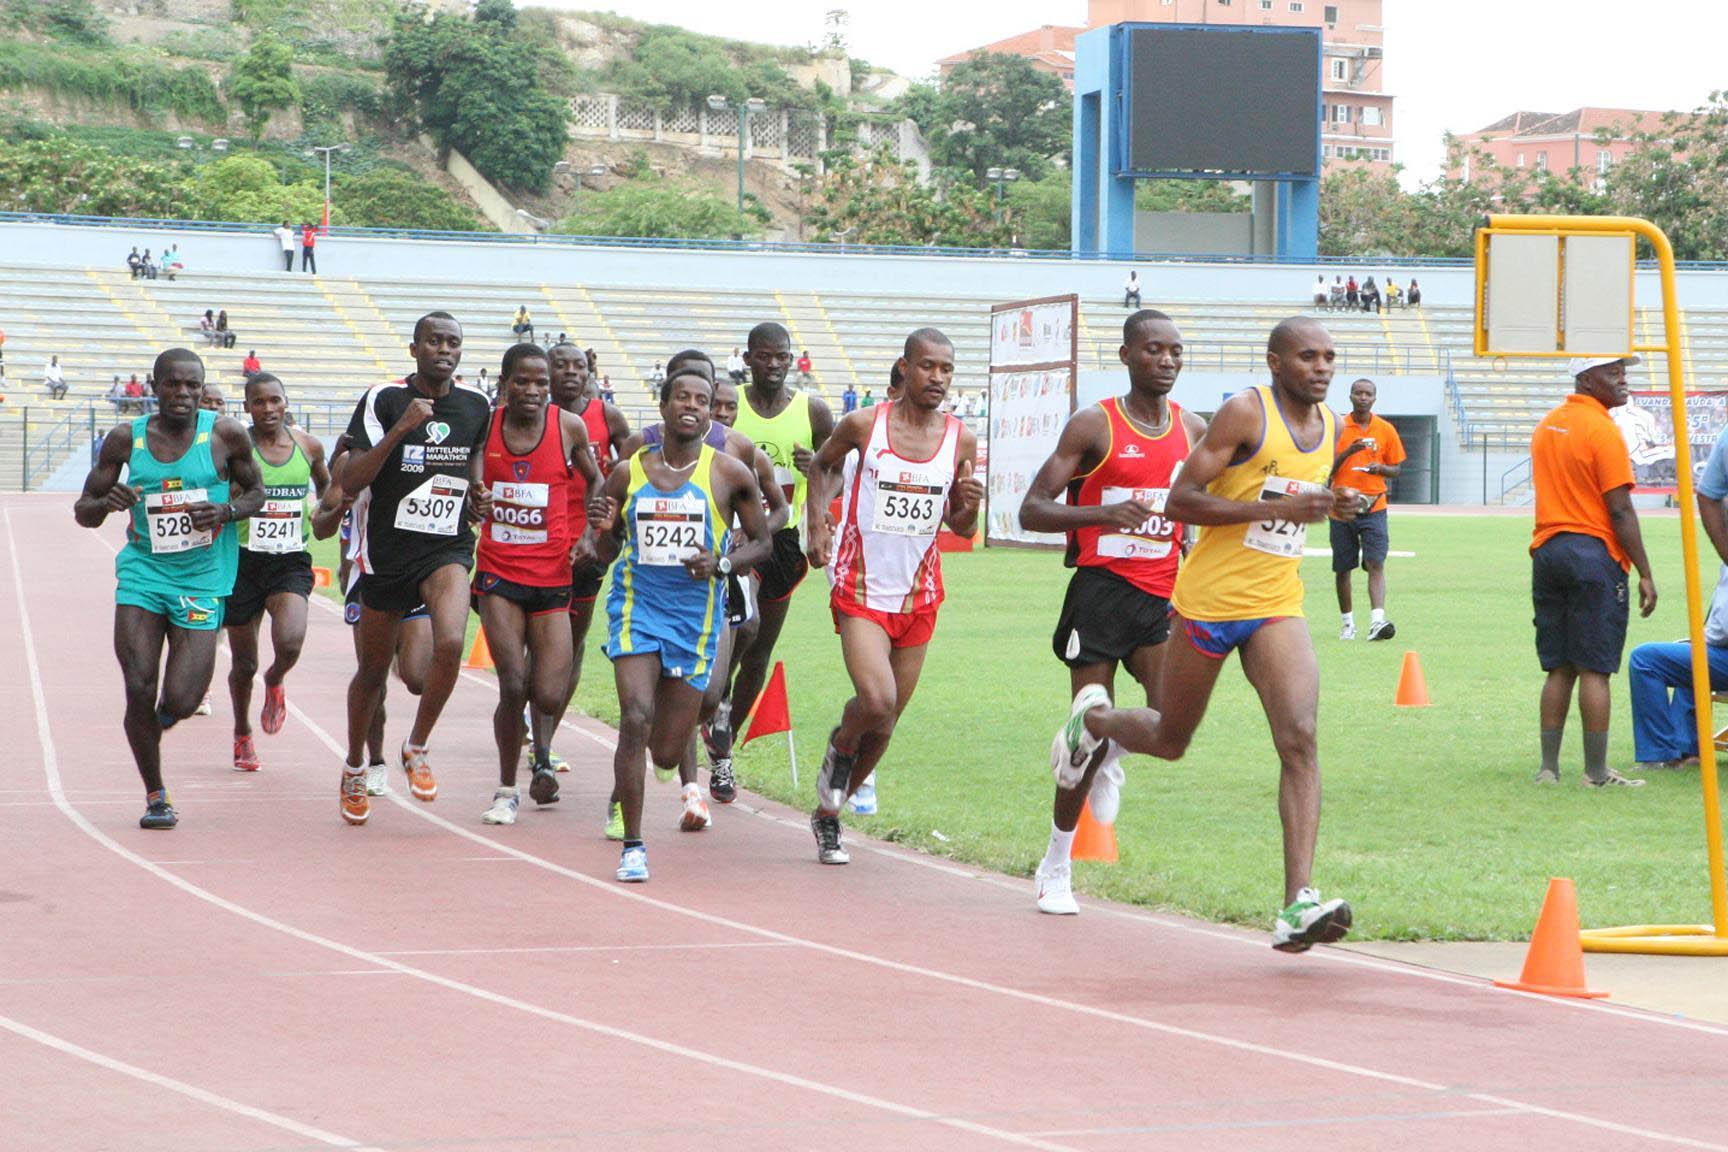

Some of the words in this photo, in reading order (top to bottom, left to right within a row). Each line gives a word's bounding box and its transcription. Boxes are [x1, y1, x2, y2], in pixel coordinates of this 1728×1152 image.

[1636, 397, 1672, 405] LUAND
[426, 453, 468, 461] MARATHON
[400, 463, 425, 473] 2009
[515, 489, 533, 499] BFA
[407, 498, 455, 519] 5309
[493, 507, 543, 525] 0066
[884, 495, 934, 520] 5363
[156, 515, 193, 538] 528
[256, 521, 296, 539] 5241
[644, 526, 697, 548] 5242
[1138, 546, 1163, 554] TOTAL
